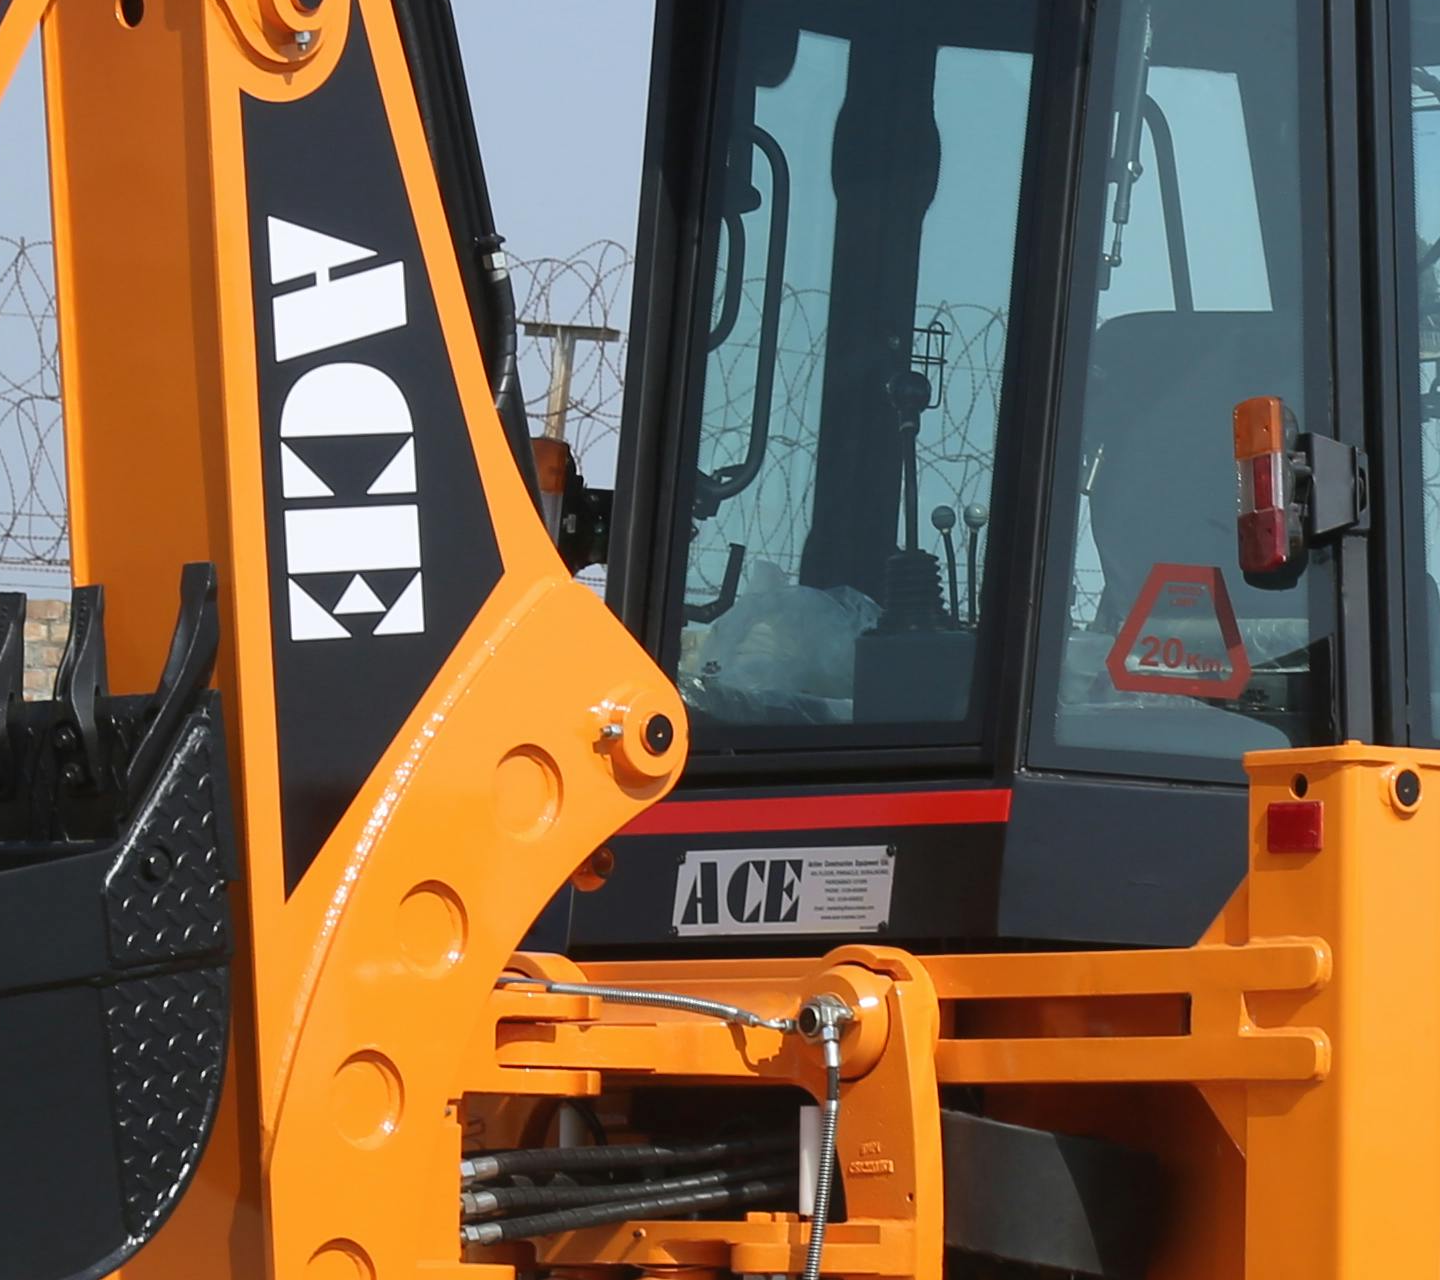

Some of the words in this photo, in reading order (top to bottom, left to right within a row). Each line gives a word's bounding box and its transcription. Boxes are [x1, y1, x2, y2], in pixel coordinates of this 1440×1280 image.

[266, 214, 426, 642] ACE
[1139, 634, 1184, 669] 20
[680, 859, 804, 925] ACE
